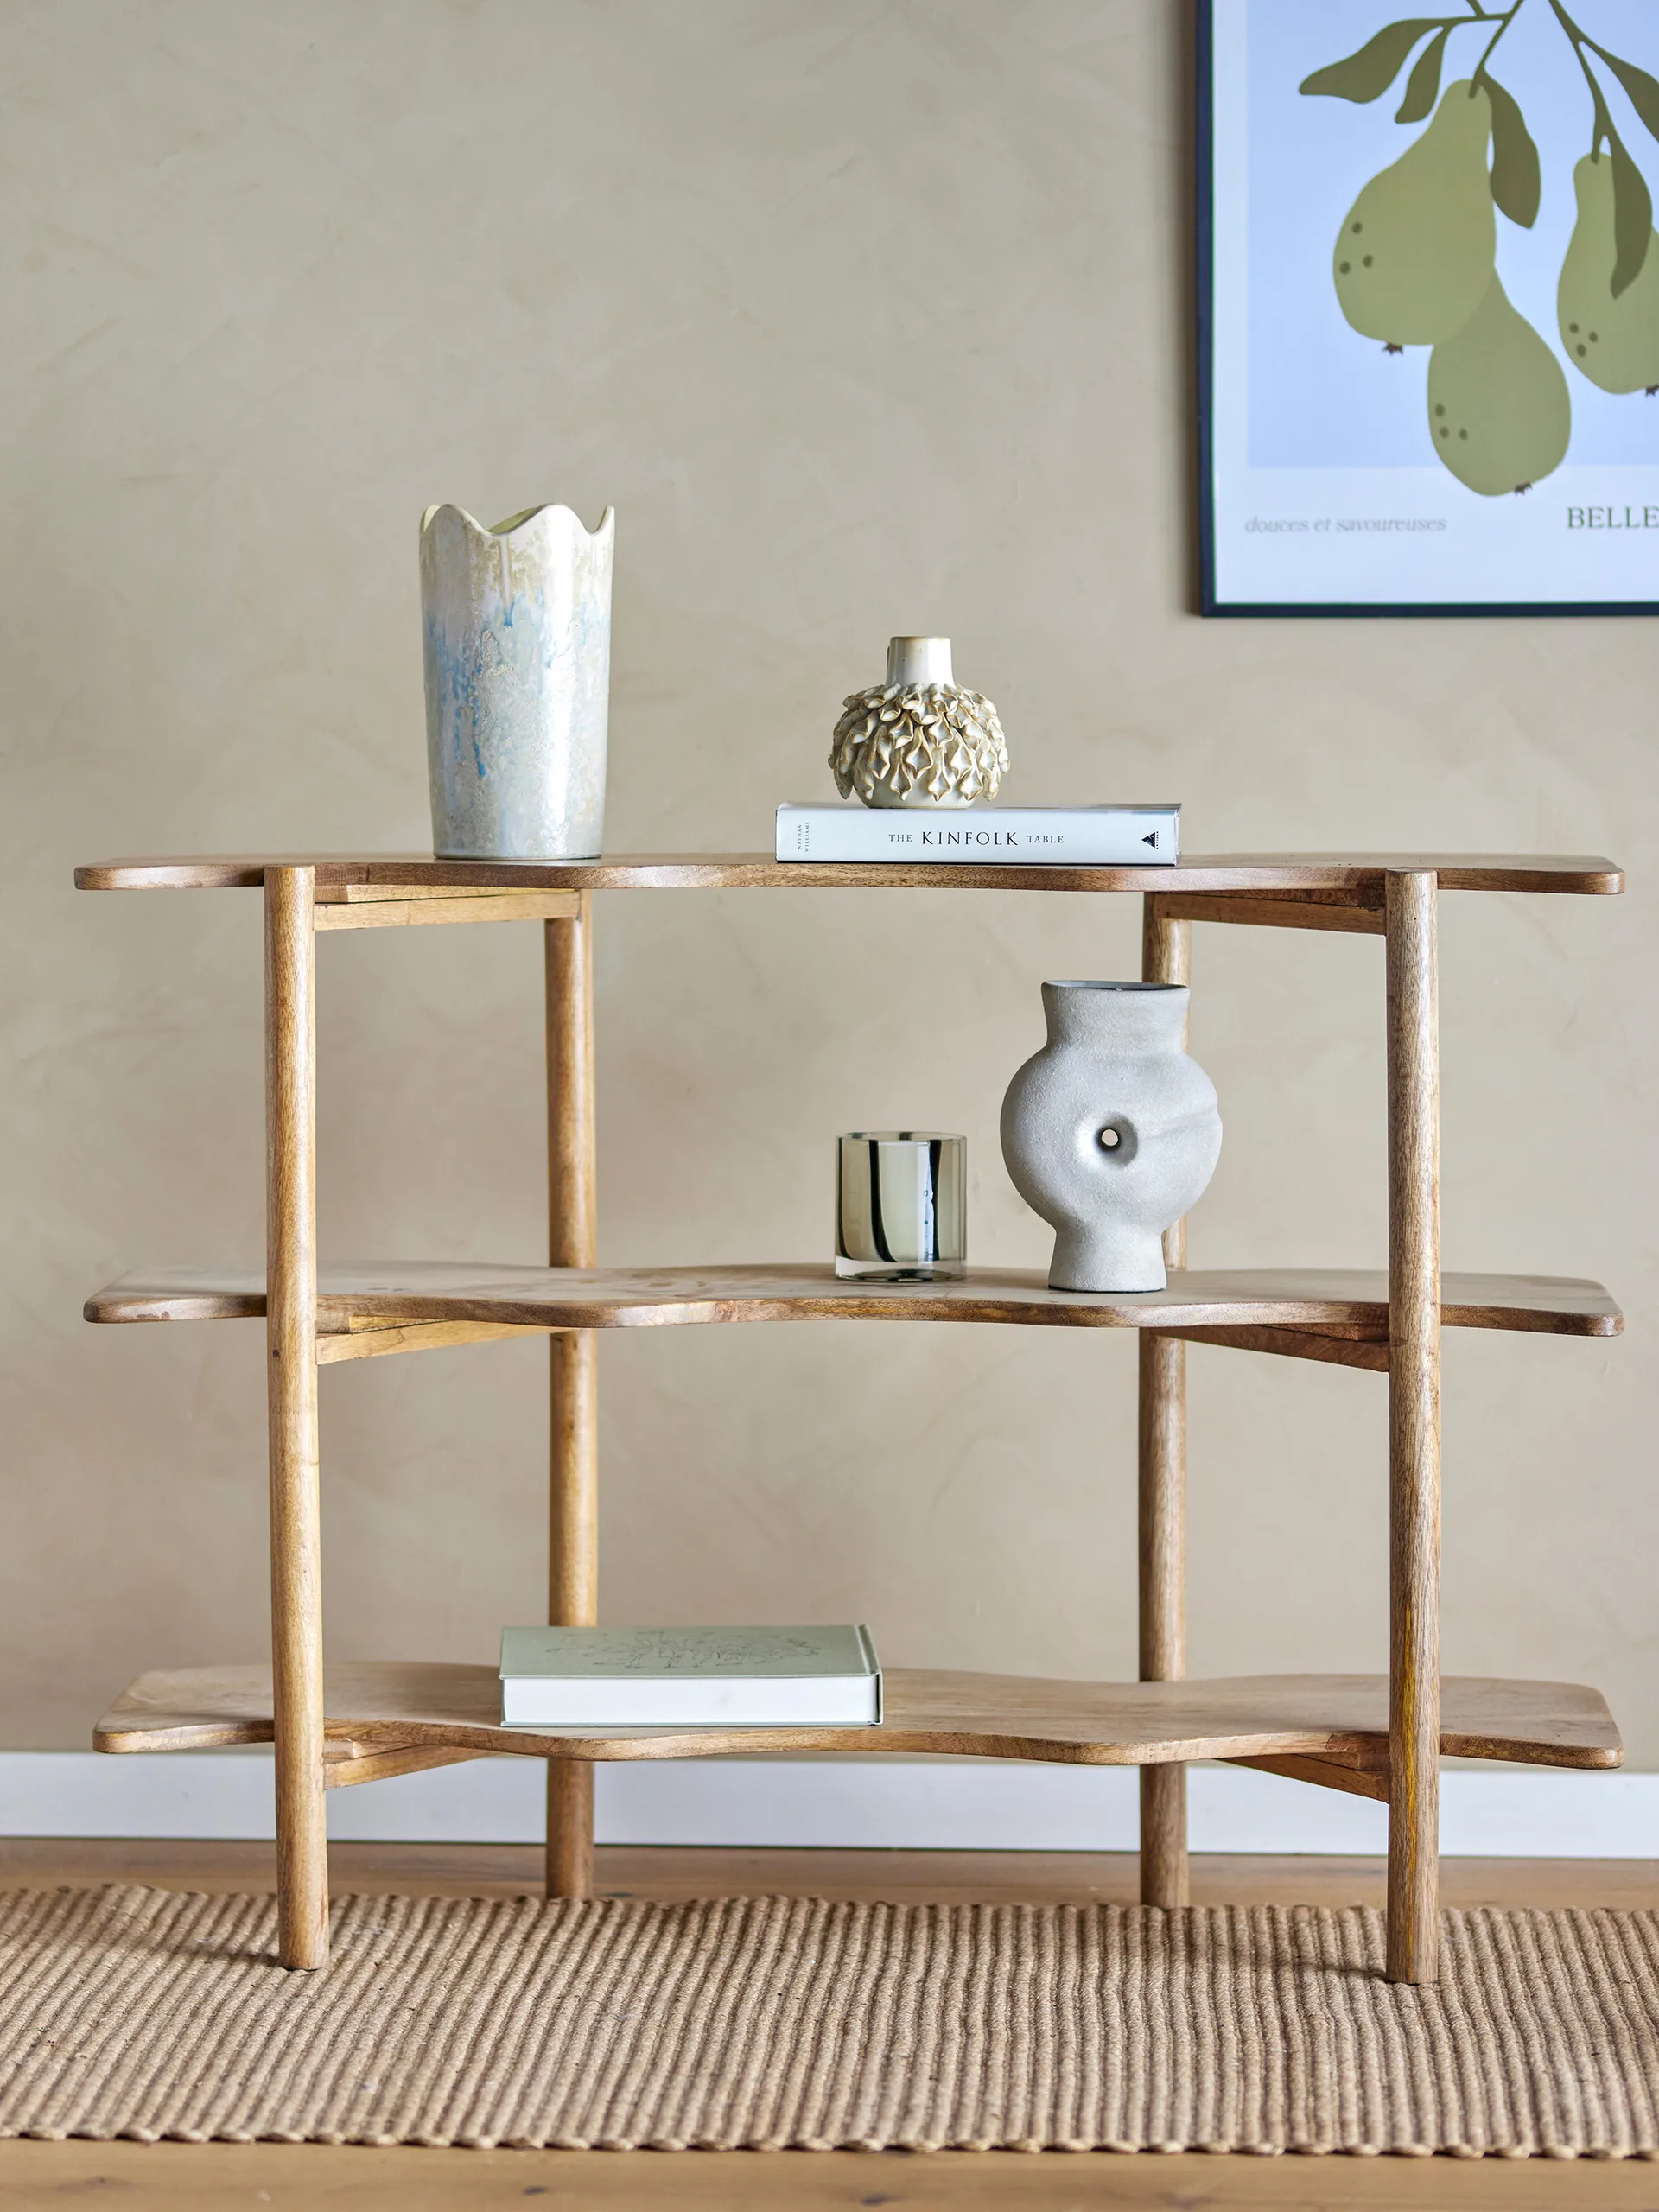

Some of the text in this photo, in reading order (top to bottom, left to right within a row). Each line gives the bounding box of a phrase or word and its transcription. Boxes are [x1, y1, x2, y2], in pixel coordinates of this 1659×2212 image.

[1244, 516, 1447, 533] douces et savoureuses
[1567, 506, 1659, 529] BELLE
[888, 831, 1065, 846] THE KINFOLK TABLE
